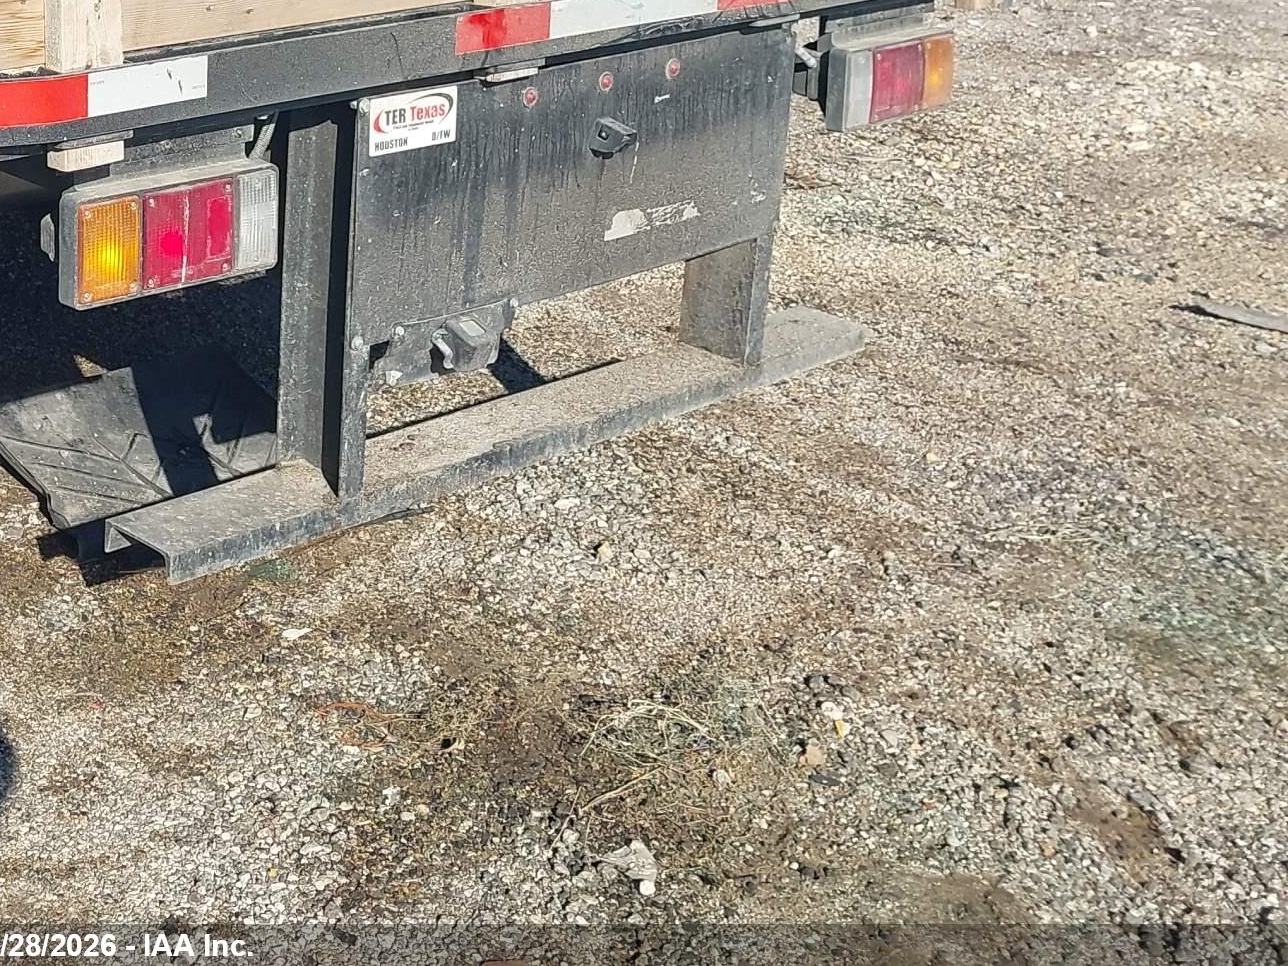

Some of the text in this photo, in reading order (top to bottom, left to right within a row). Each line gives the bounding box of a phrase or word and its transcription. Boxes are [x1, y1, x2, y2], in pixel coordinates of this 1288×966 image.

[384, 108, 406, 126] TER
[409, 104, 446, 122] Texas
[374, 137, 408, 152] HOUSTON
